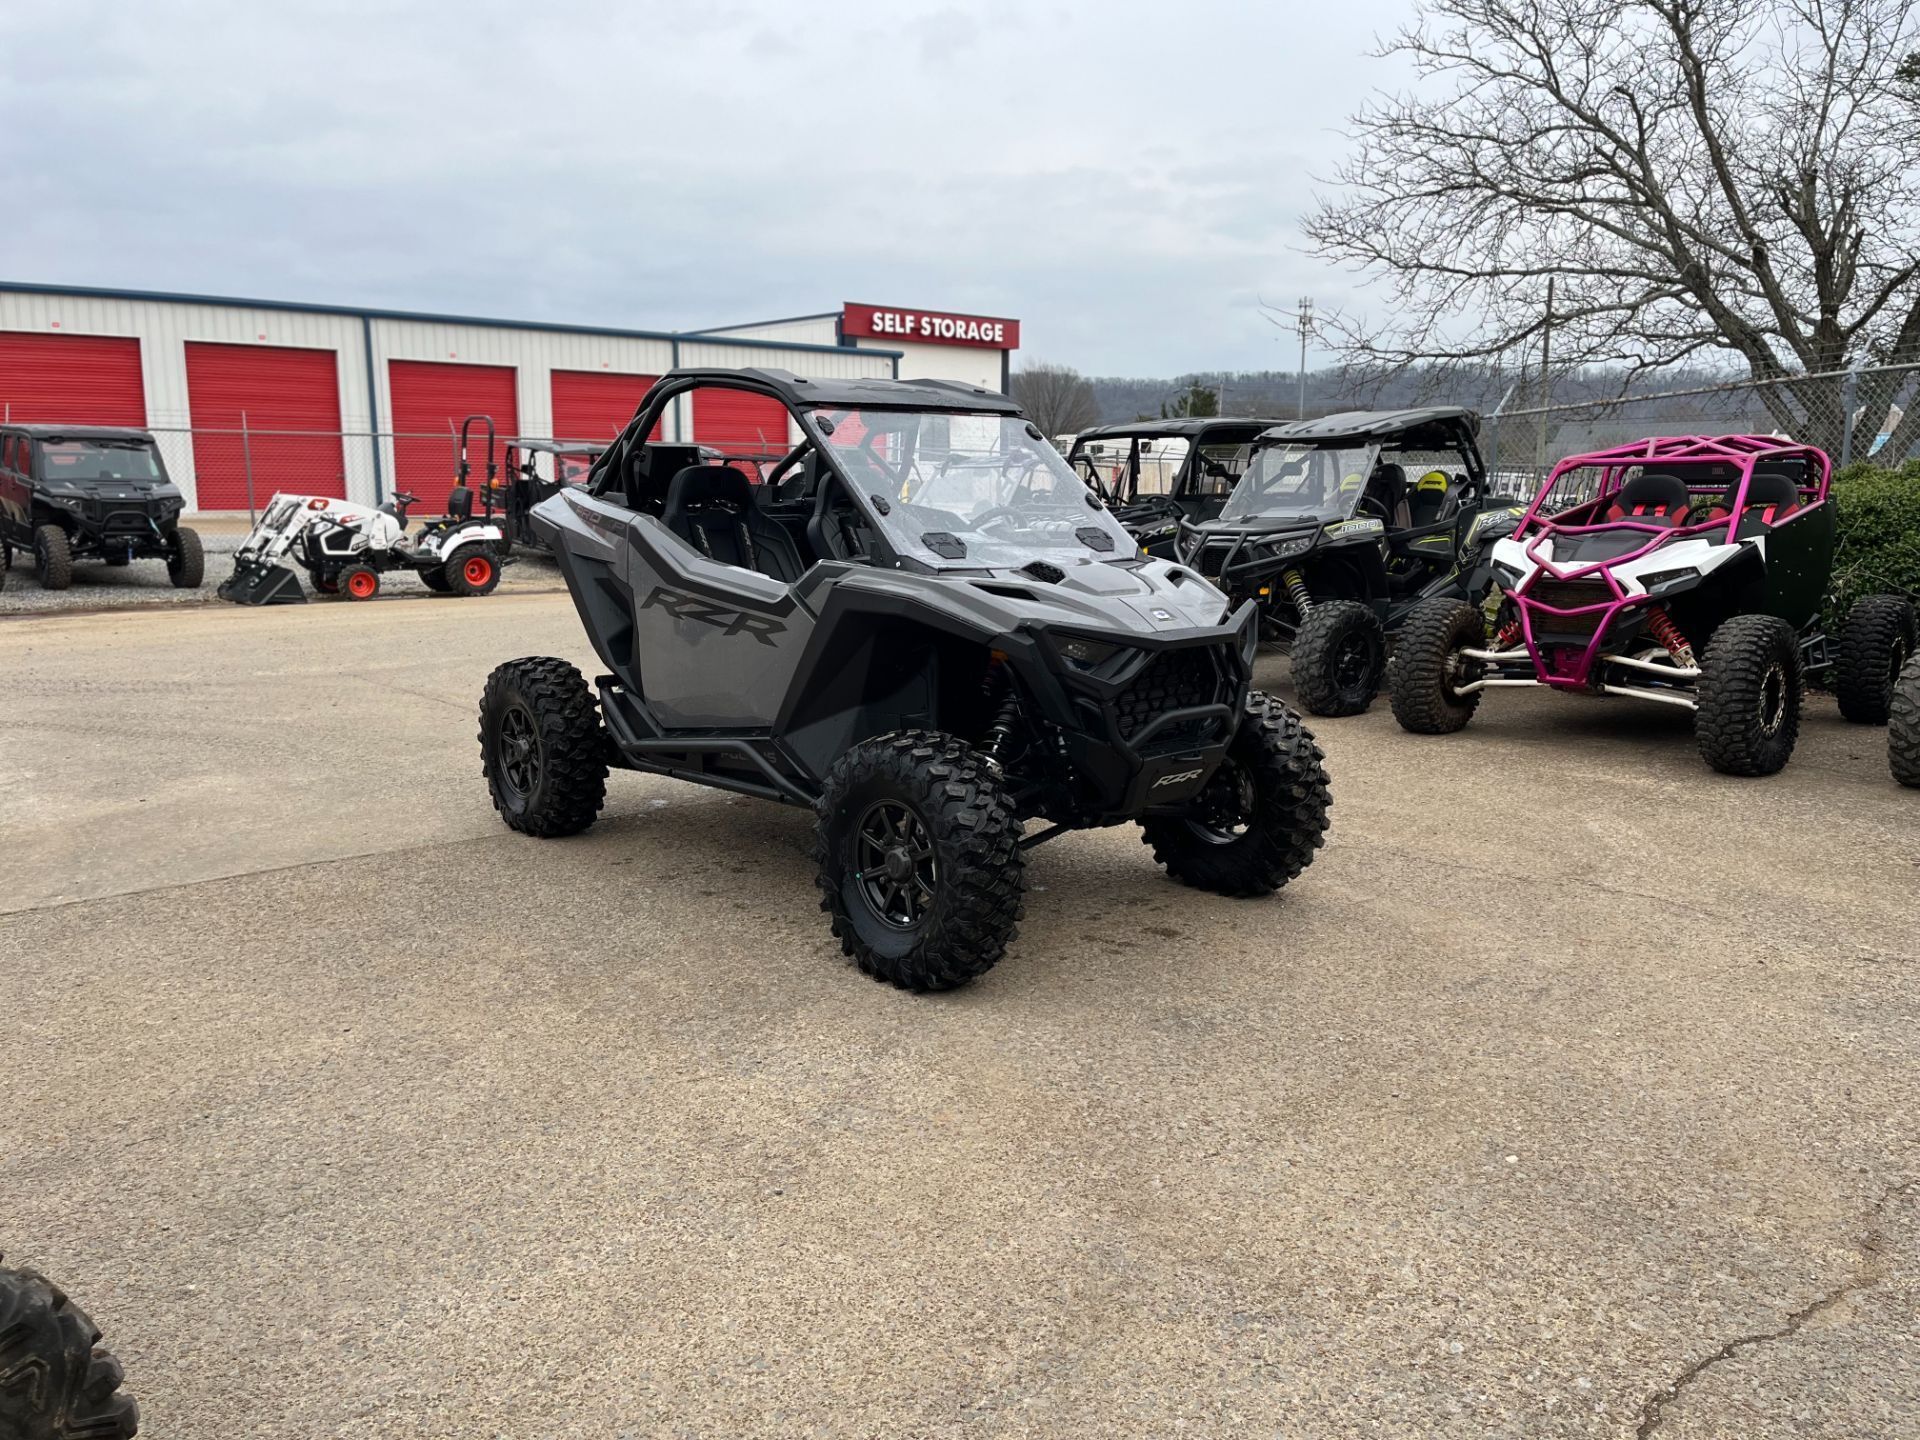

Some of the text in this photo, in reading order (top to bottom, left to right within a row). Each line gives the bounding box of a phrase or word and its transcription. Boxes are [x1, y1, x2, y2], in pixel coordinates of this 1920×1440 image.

[872, 312, 1004, 342] SELF STORAGE
[1342, 520, 1376, 533] 1000
[1477, 511, 1510, 531] RZR
[640, 586, 788, 648] RZR
[1151, 768, 1203, 789] RZR
